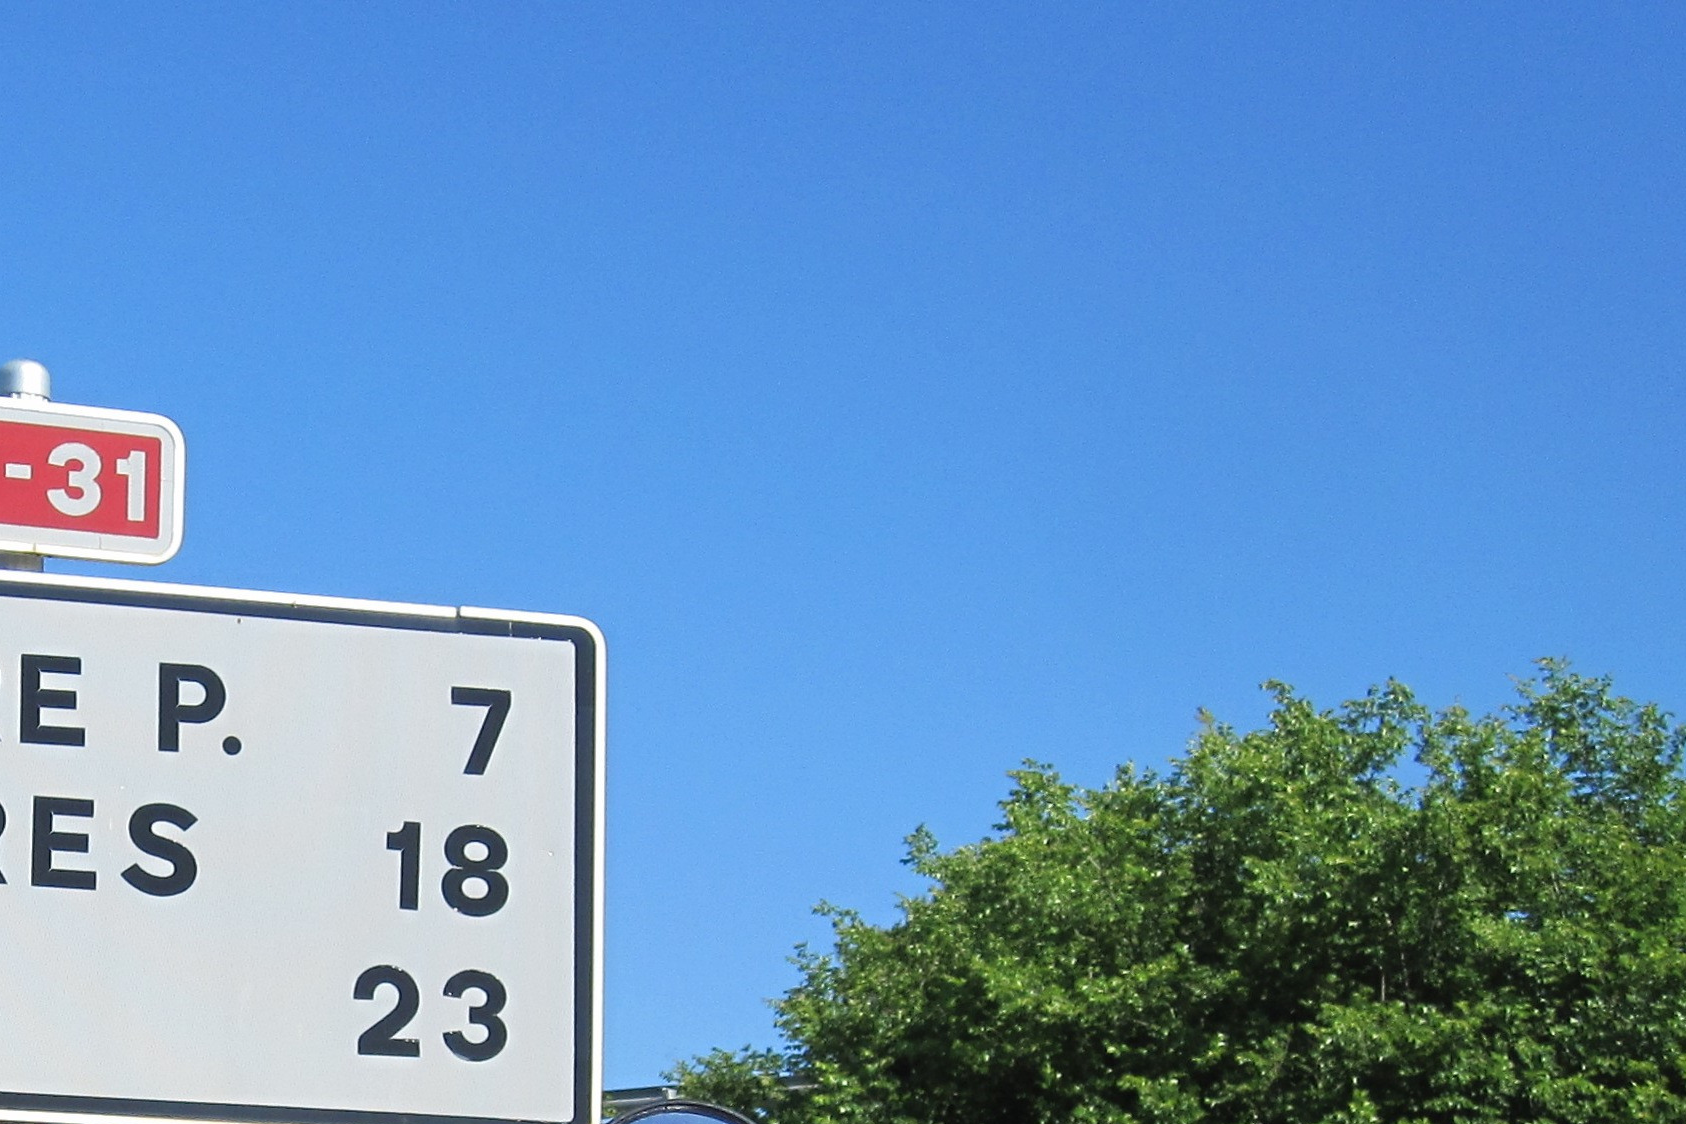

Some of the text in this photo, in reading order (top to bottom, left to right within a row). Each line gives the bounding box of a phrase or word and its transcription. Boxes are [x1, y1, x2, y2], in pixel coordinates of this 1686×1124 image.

[158, 662, 242, 756] P.
[450, 686, 512, 776] 7
[386, 821, 509, 918] 18
[353, 964, 508, 1062] 23
